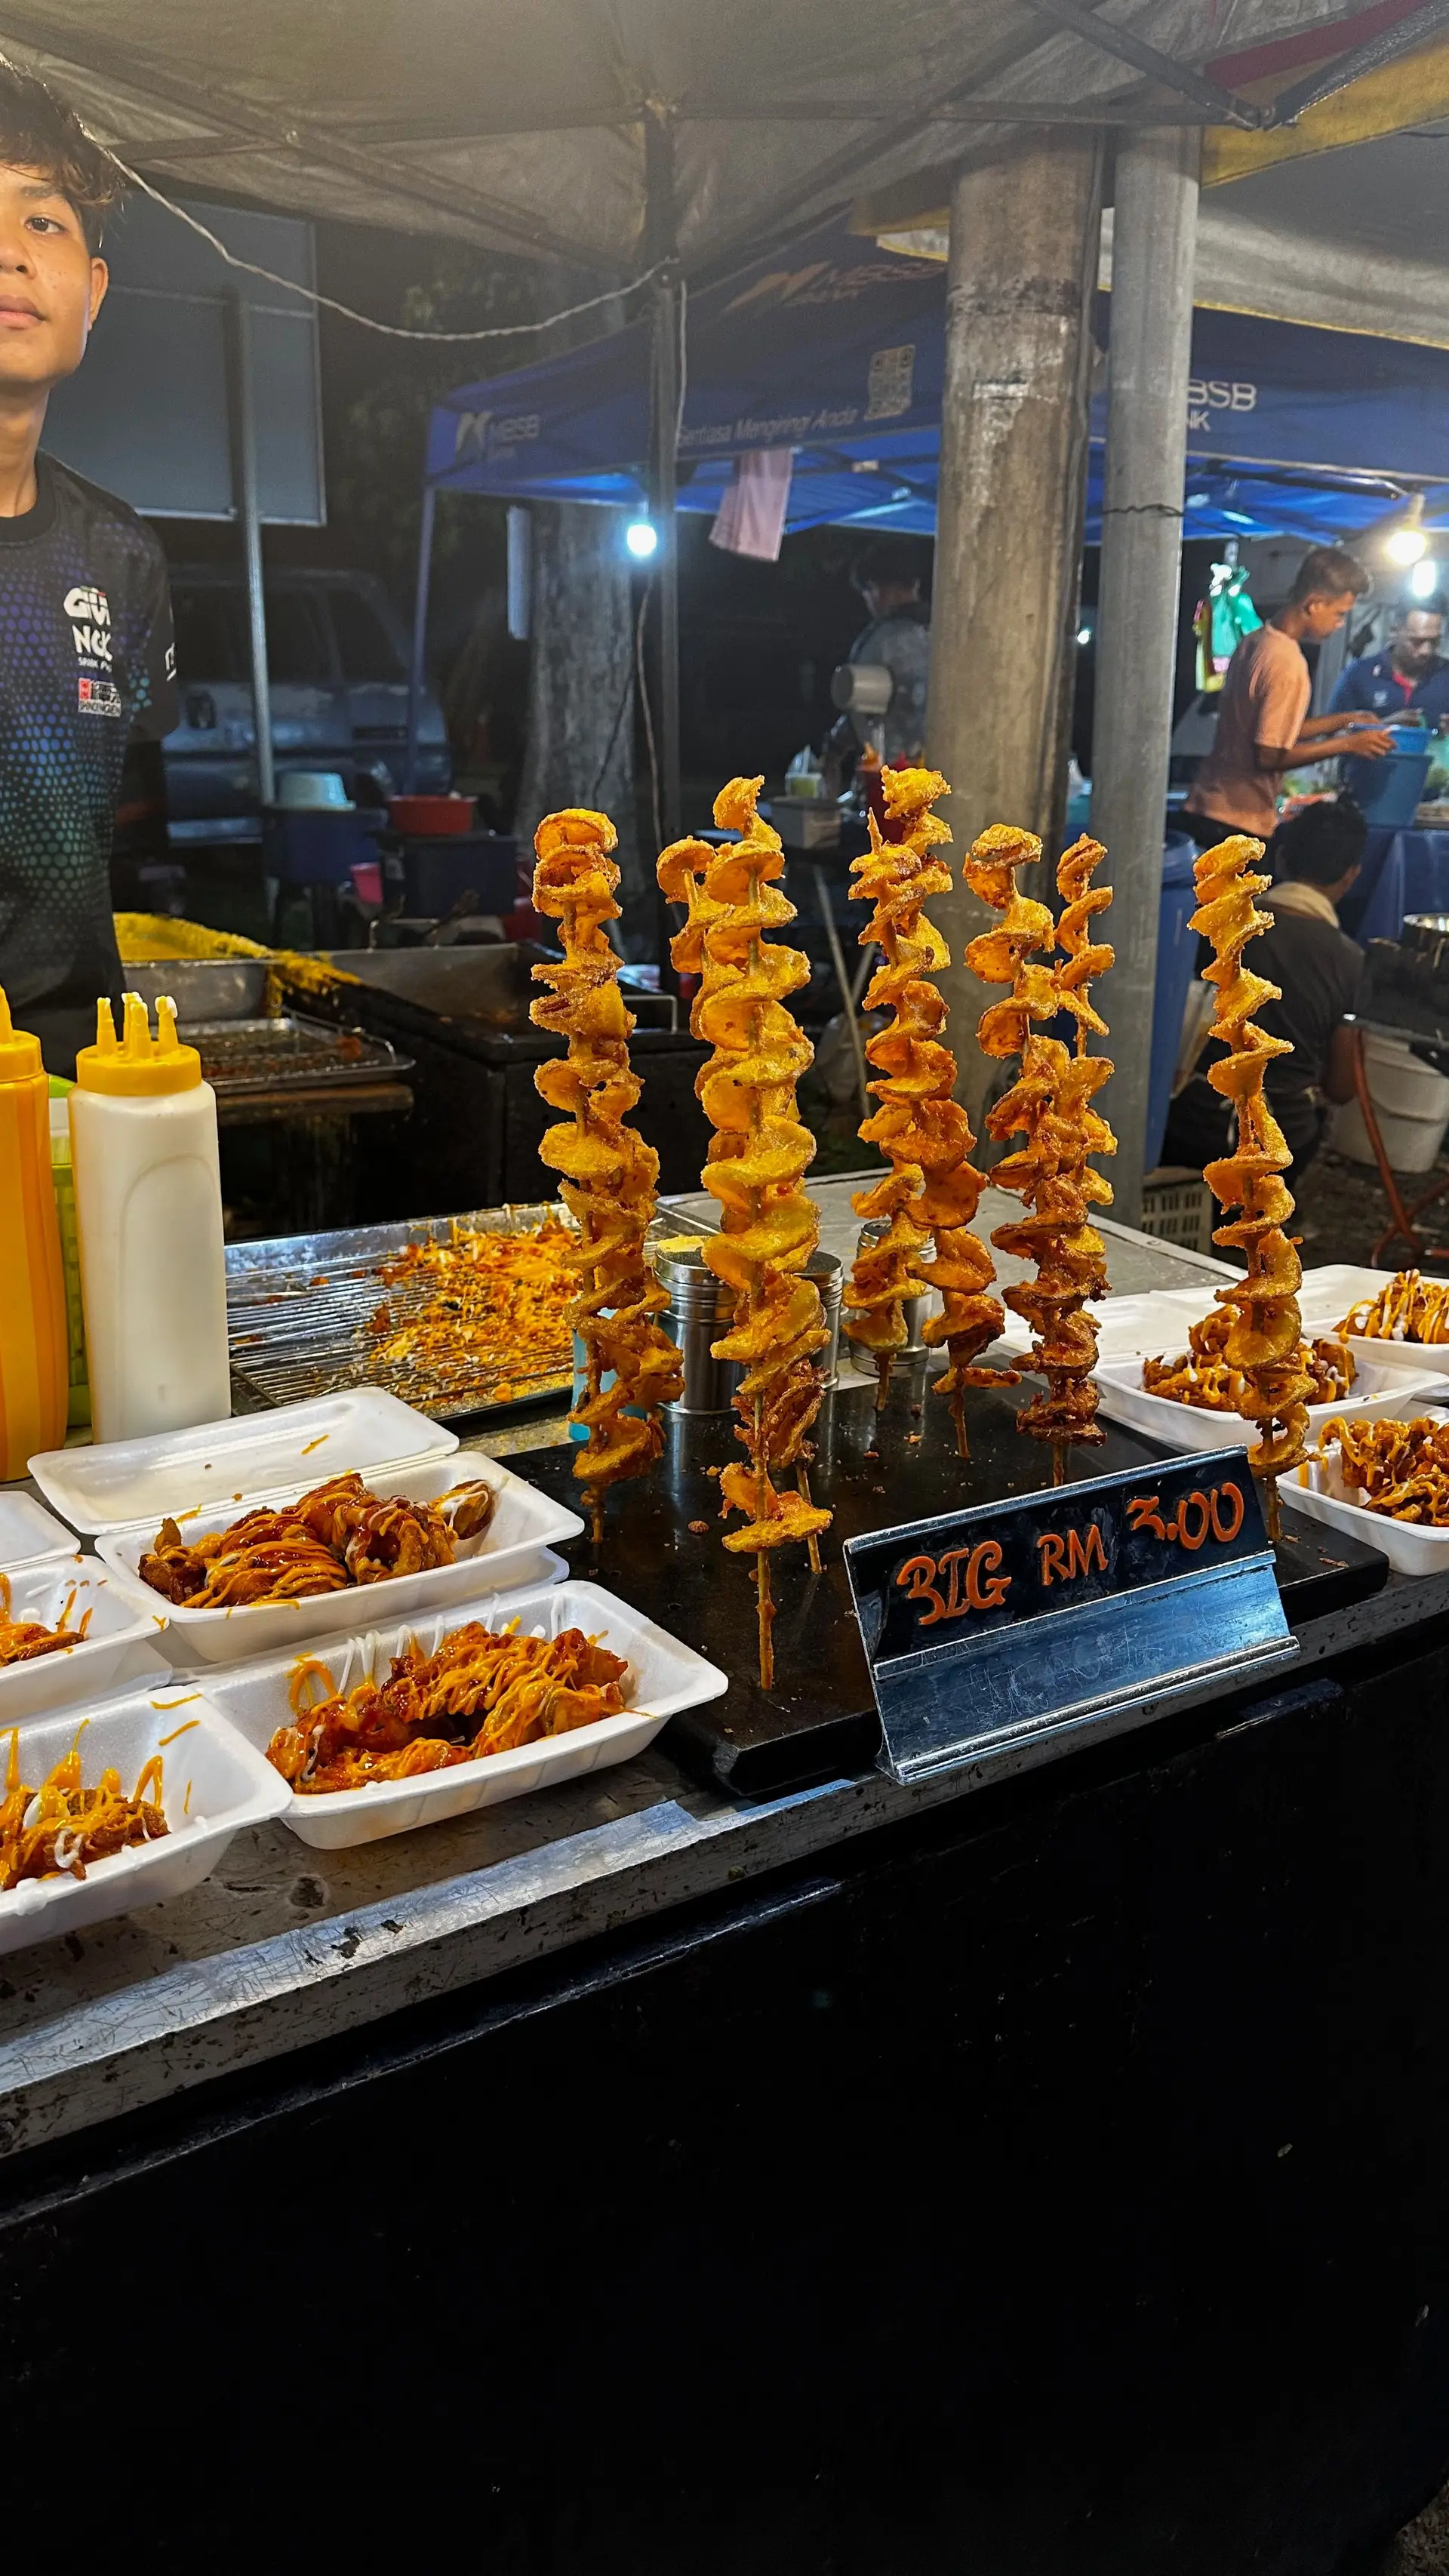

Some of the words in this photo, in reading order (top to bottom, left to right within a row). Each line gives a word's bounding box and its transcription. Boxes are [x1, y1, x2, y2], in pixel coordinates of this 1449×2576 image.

[1188, 378, 1257, 411] BSB
[1188, 410, 1211, 432] NK
[72, 625, 112, 661] NGK
[897, 1540, 1013, 1626] BIG
[1037, 1524, 1109, 1586] RM
[1126, 1482, 1244, 1550] 3.00
